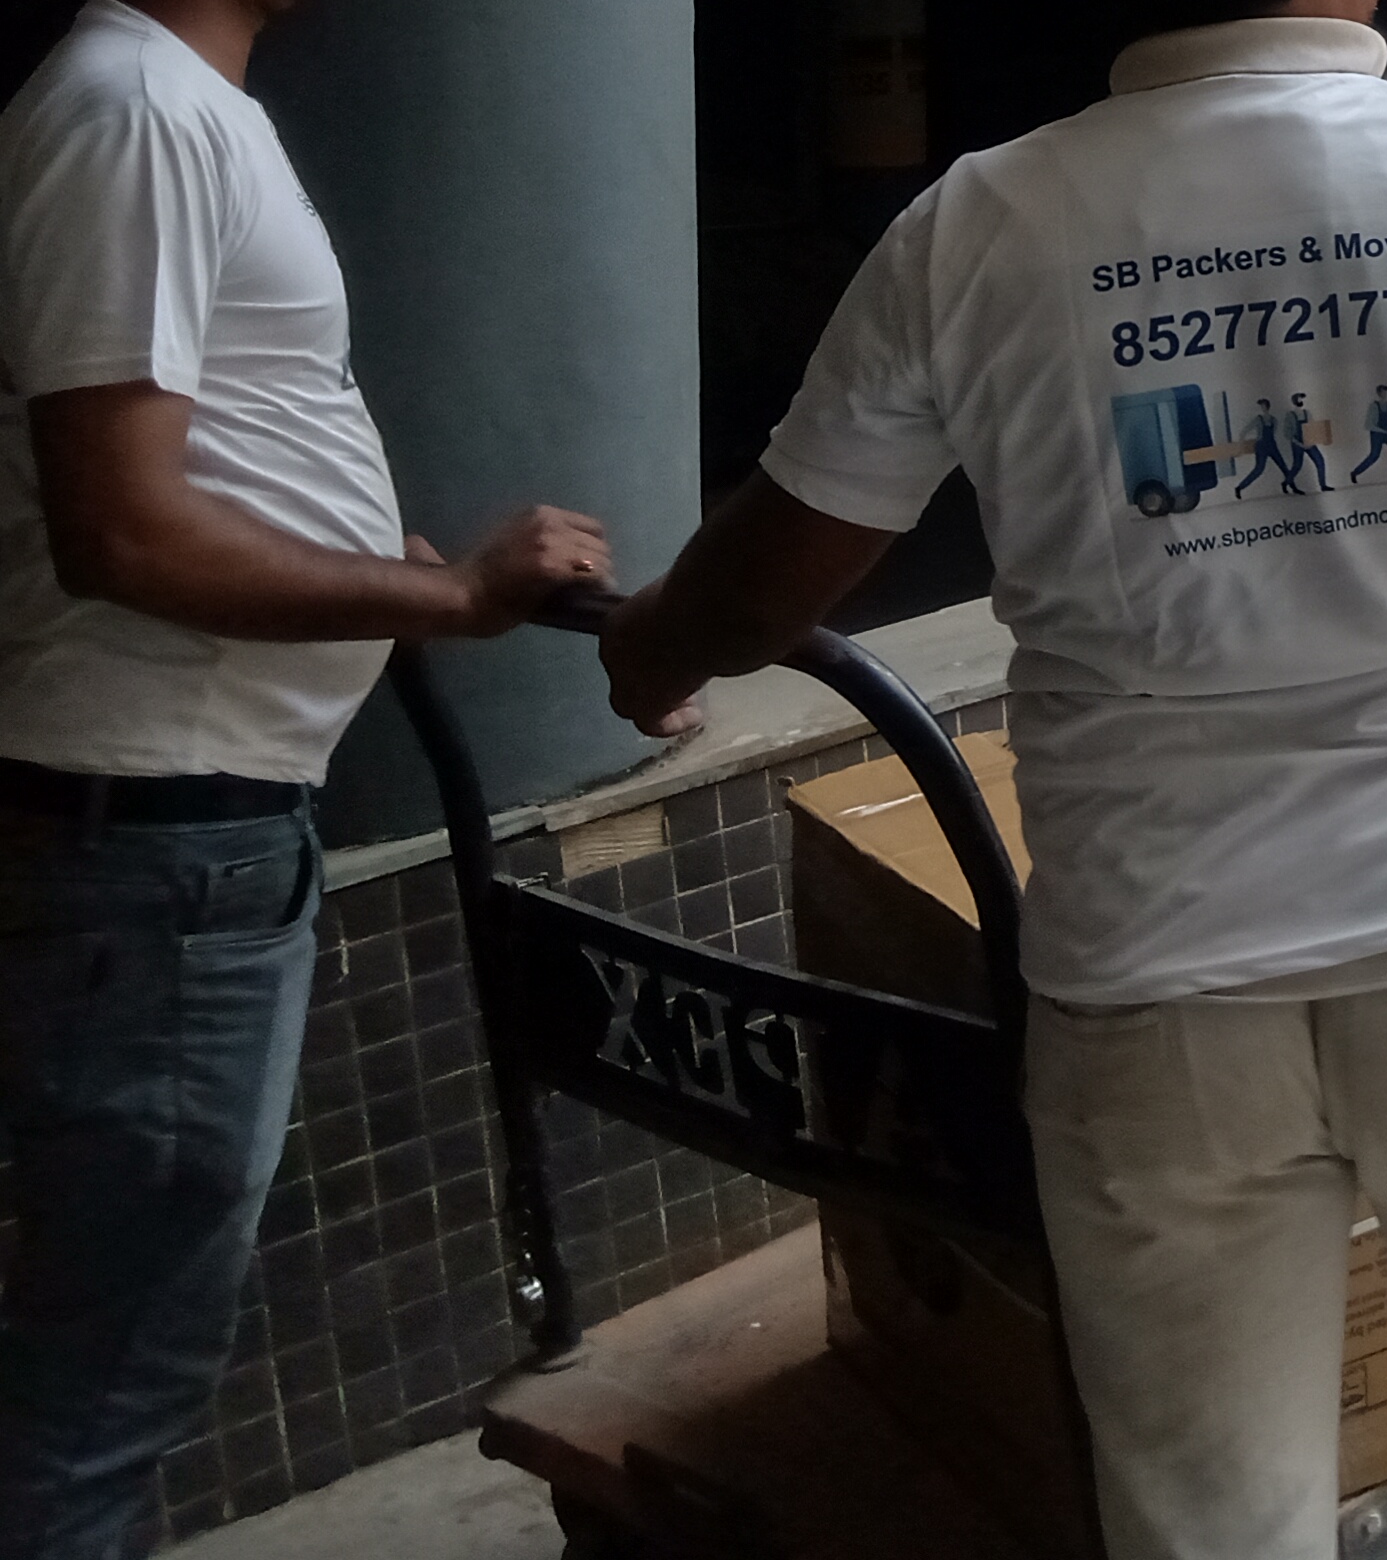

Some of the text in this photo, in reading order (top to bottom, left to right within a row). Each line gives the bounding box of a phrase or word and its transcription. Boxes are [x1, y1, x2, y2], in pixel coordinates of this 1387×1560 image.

[1092, 259, 1141, 293] SB
[1152, 245, 1287, 283] Packers
[1299, 236, 1323, 264] &
